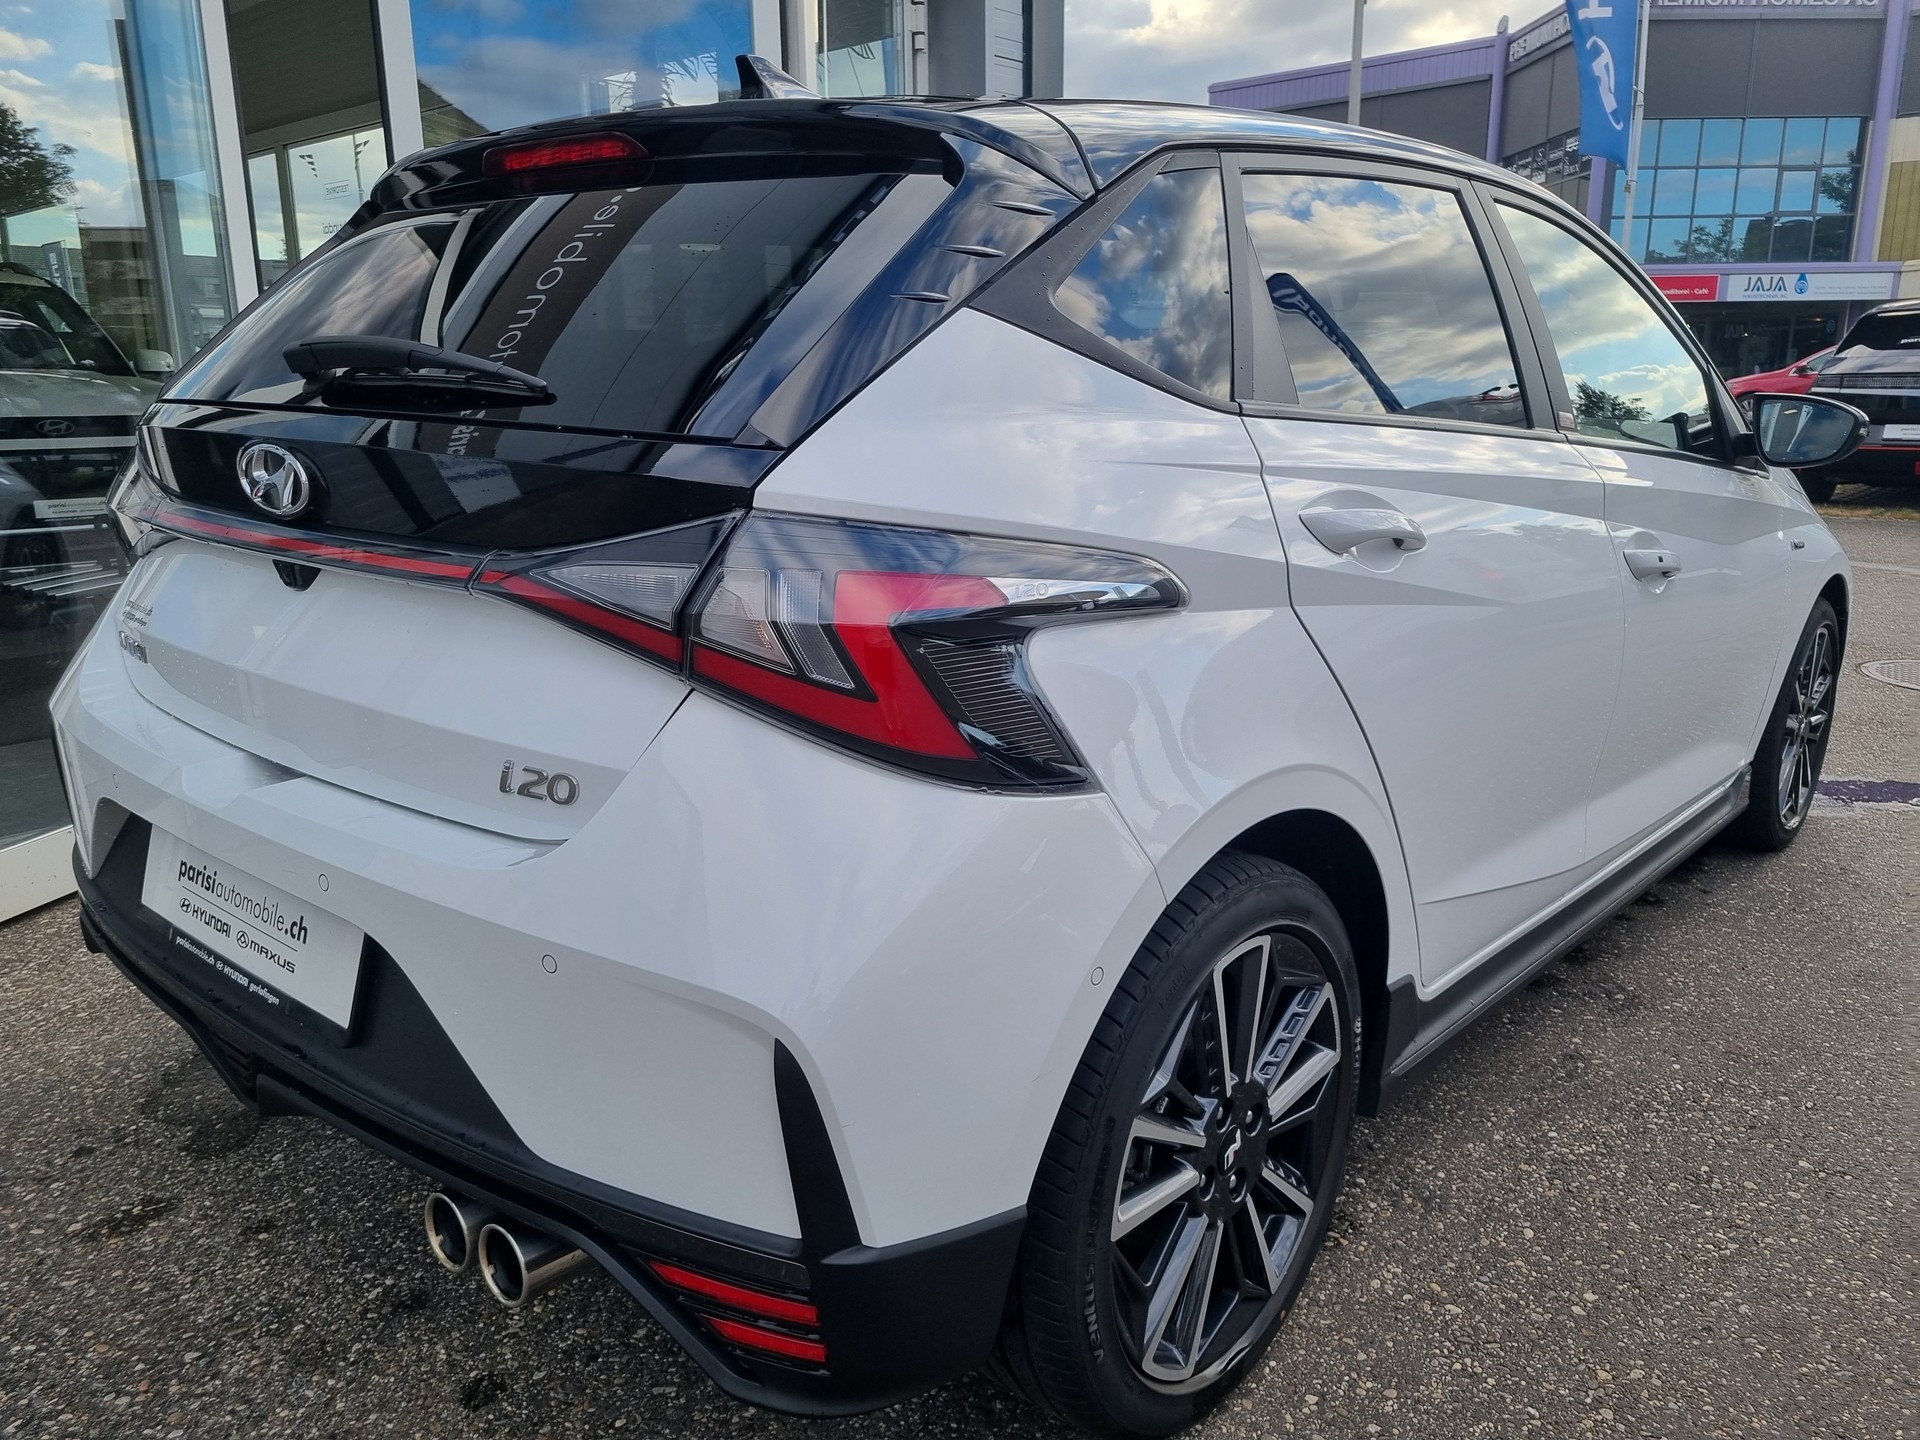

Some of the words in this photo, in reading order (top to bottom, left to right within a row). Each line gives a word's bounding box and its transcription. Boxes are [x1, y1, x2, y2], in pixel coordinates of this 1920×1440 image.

[1743, 276, 1788, 292] JAJA
[178, 859, 308, 945] parisiautomobile.ch
[191, 904, 232, 939] HYUNDAI
[249, 939, 297, 974] MAXUS
[223, 964, 249, 988] HYUNDAI
